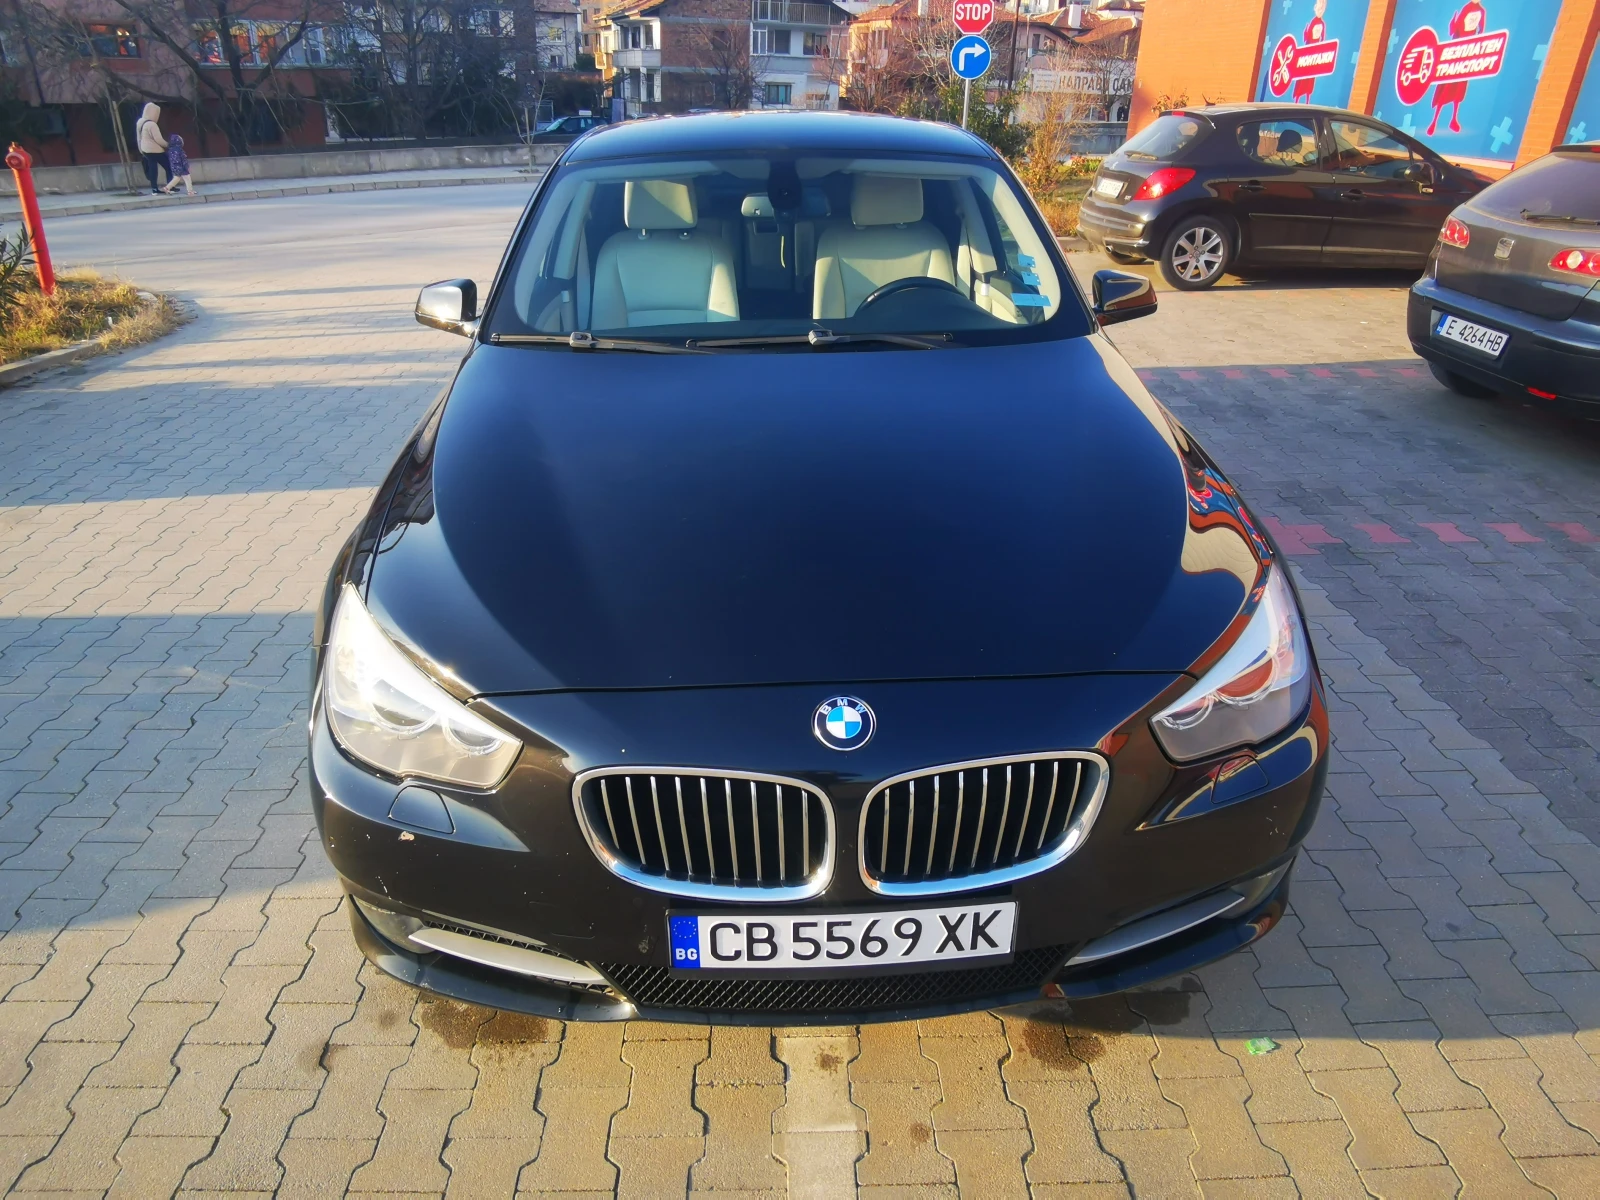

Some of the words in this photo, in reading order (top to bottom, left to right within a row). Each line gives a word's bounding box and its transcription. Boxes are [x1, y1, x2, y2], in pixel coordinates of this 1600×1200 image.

[956, 4, 990, 20] STOP
[1440, 37, 1504, 61] БЕЗПЛАТЕН
[1436, 55, 1498, 77] ТРАНСПОРТ
[1446, 319, 1458, 336] E
[819, 698, 867, 715] BMW
[709, 922, 778, 962] CB
[792, 918, 923, 962] 5569
[935, 909, 1003, 954] XK
[675, 948, 698, 961] BG
